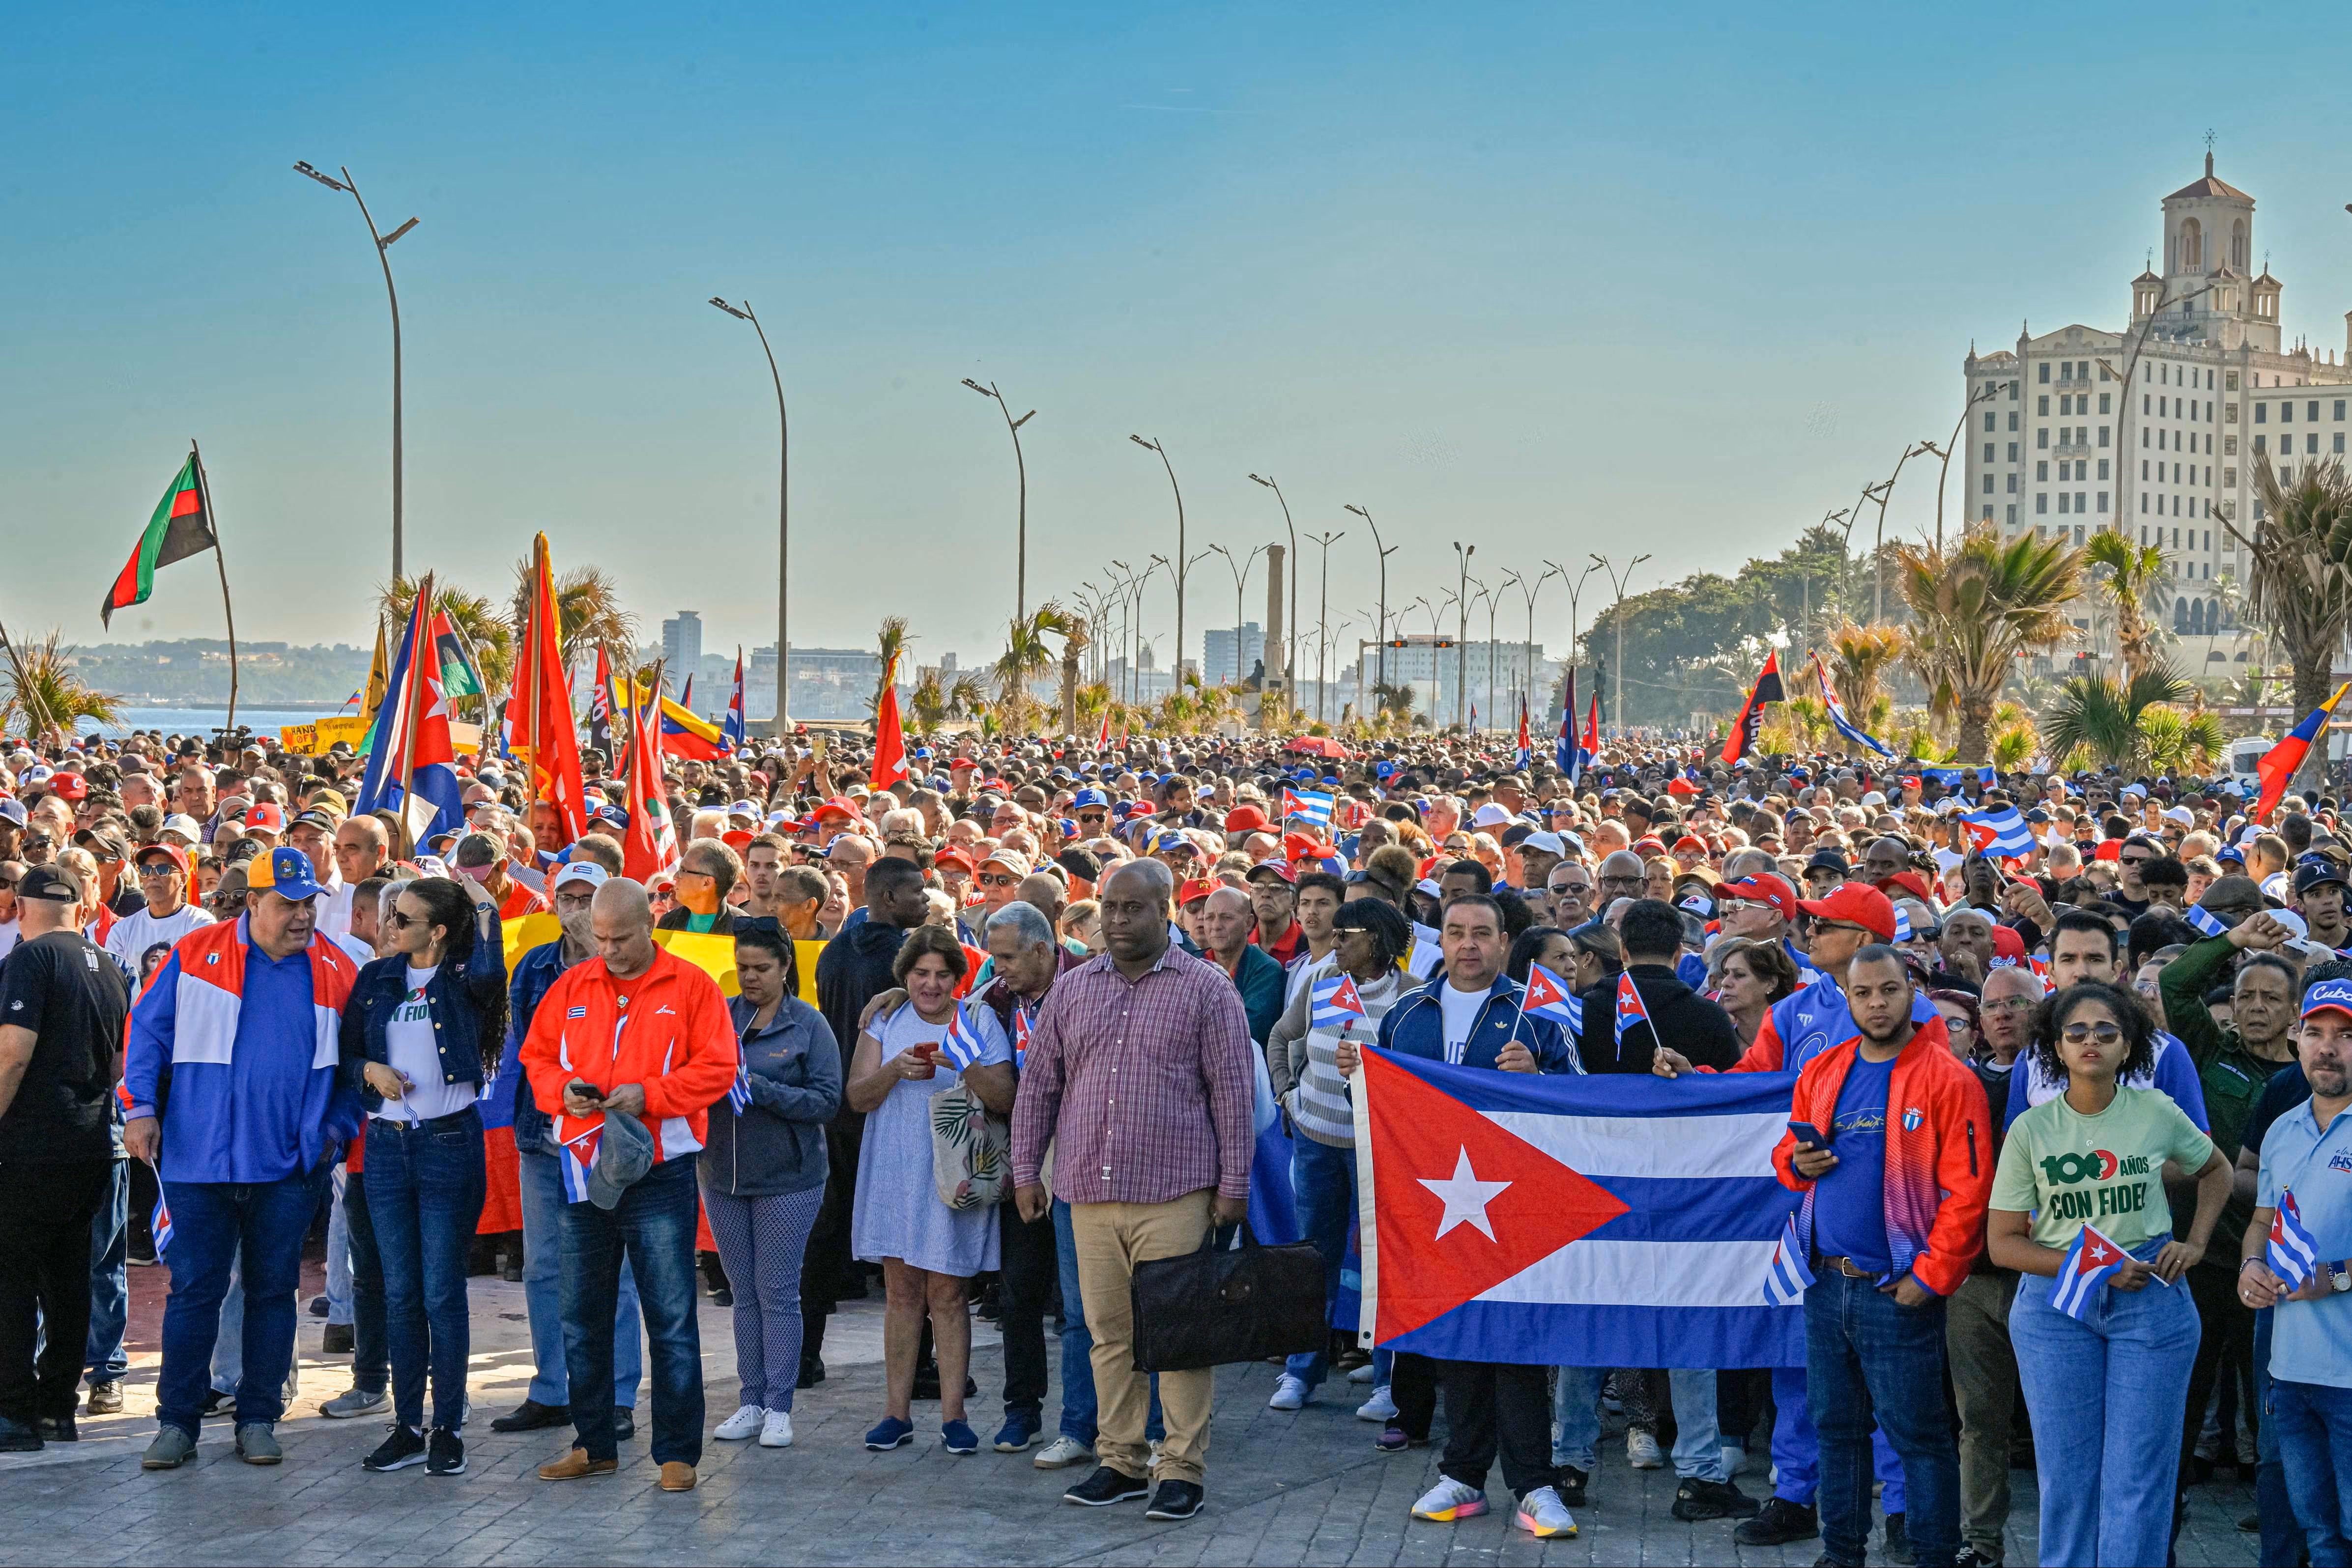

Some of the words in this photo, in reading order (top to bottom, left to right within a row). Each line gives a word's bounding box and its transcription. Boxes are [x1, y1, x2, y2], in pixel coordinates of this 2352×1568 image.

[72, 777, 82, 789] C
[2313, 985, 2352, 1001] Cuba
[404, 1004, 430, 1022] FID
[2120, 1155, 2150, 1177] AÑOS
[2050, 1190, 2093, 1220] CON
